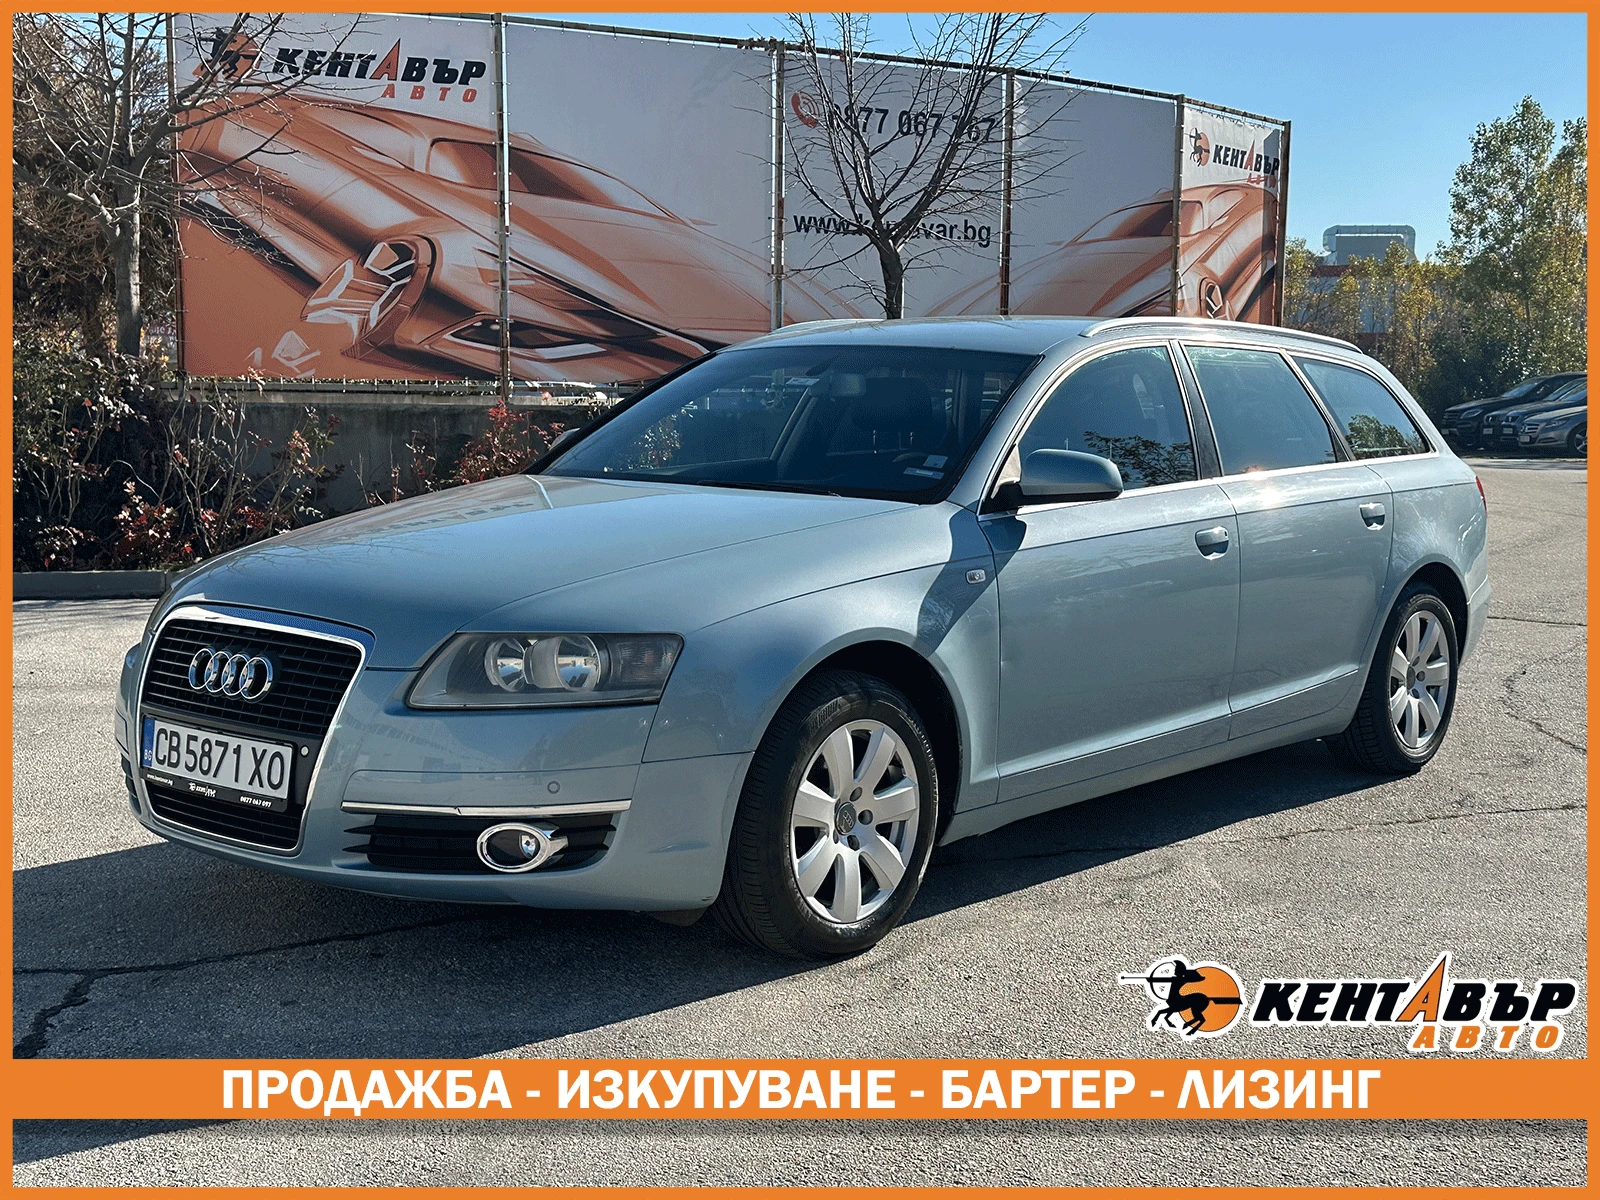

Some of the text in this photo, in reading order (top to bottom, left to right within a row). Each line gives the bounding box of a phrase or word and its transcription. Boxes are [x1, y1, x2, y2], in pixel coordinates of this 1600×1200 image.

[272, 38, 486, 85] КЕНТАВЪР
[381, 83, 478, 103] АВТО
[899, 110, 942, 138] 067
[952, 115, 995, 142] 67
